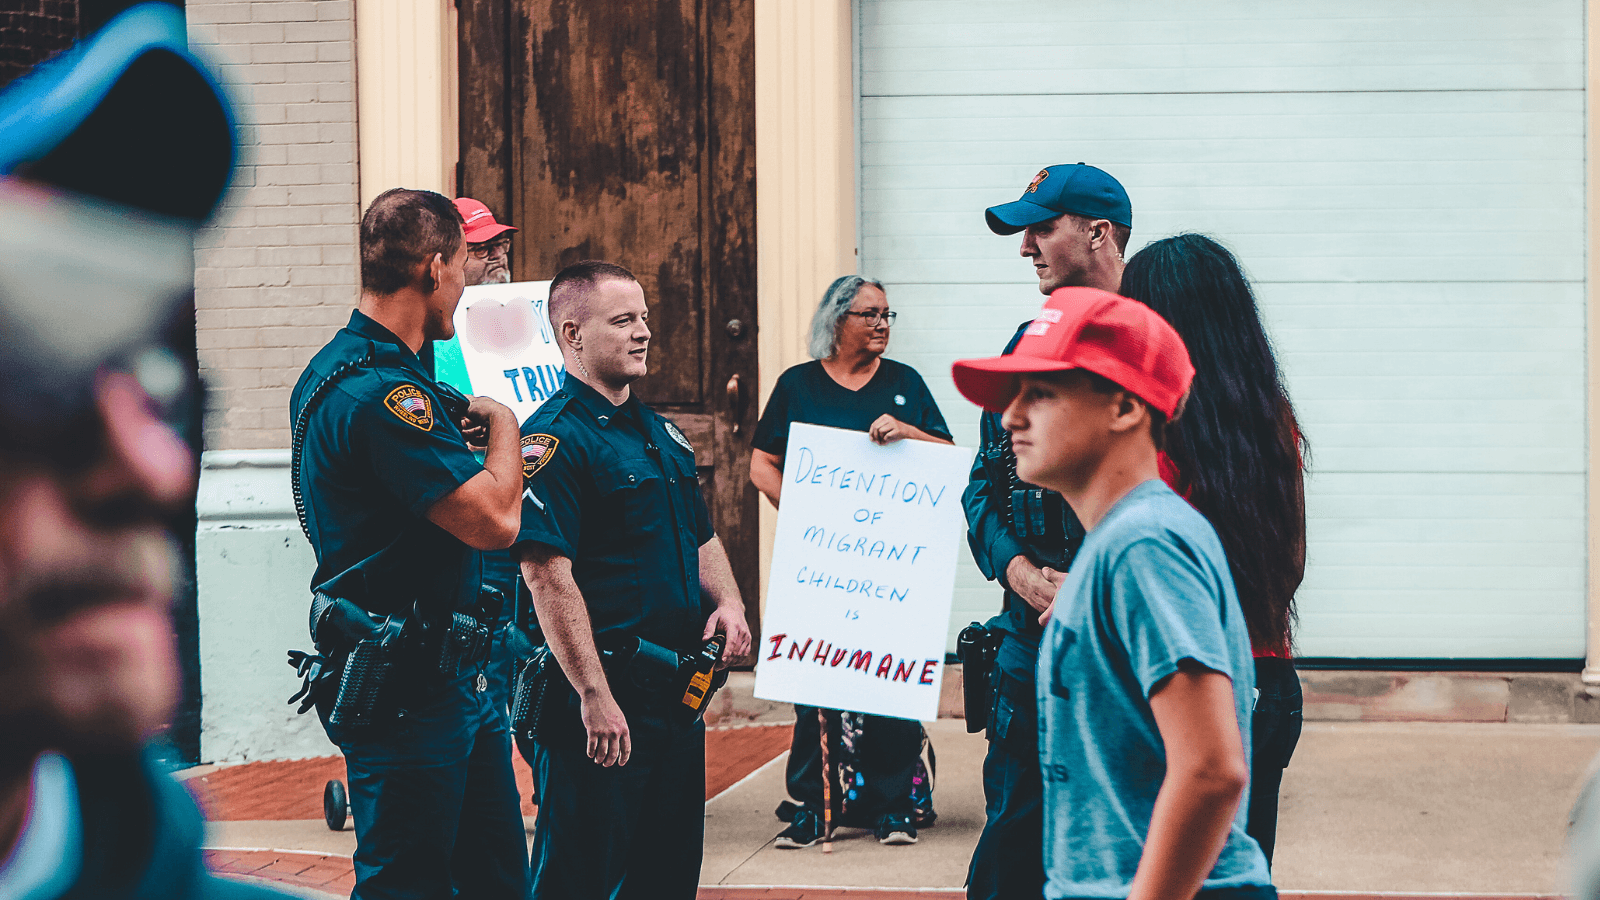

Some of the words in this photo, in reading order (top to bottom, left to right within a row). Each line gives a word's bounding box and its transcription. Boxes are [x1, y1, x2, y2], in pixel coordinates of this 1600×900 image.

[391, 388, 422, 403] POLICE
[795, 446, 946, 507] DETENTION
[853, 508, 883, 525] OF
[803, 525, 926, 564] MIGRANT
[796, 566, 909, 602] CHILDREN
[845, 608, 860, 621] IS
[767, 633, 940, 686] INHUMANE
